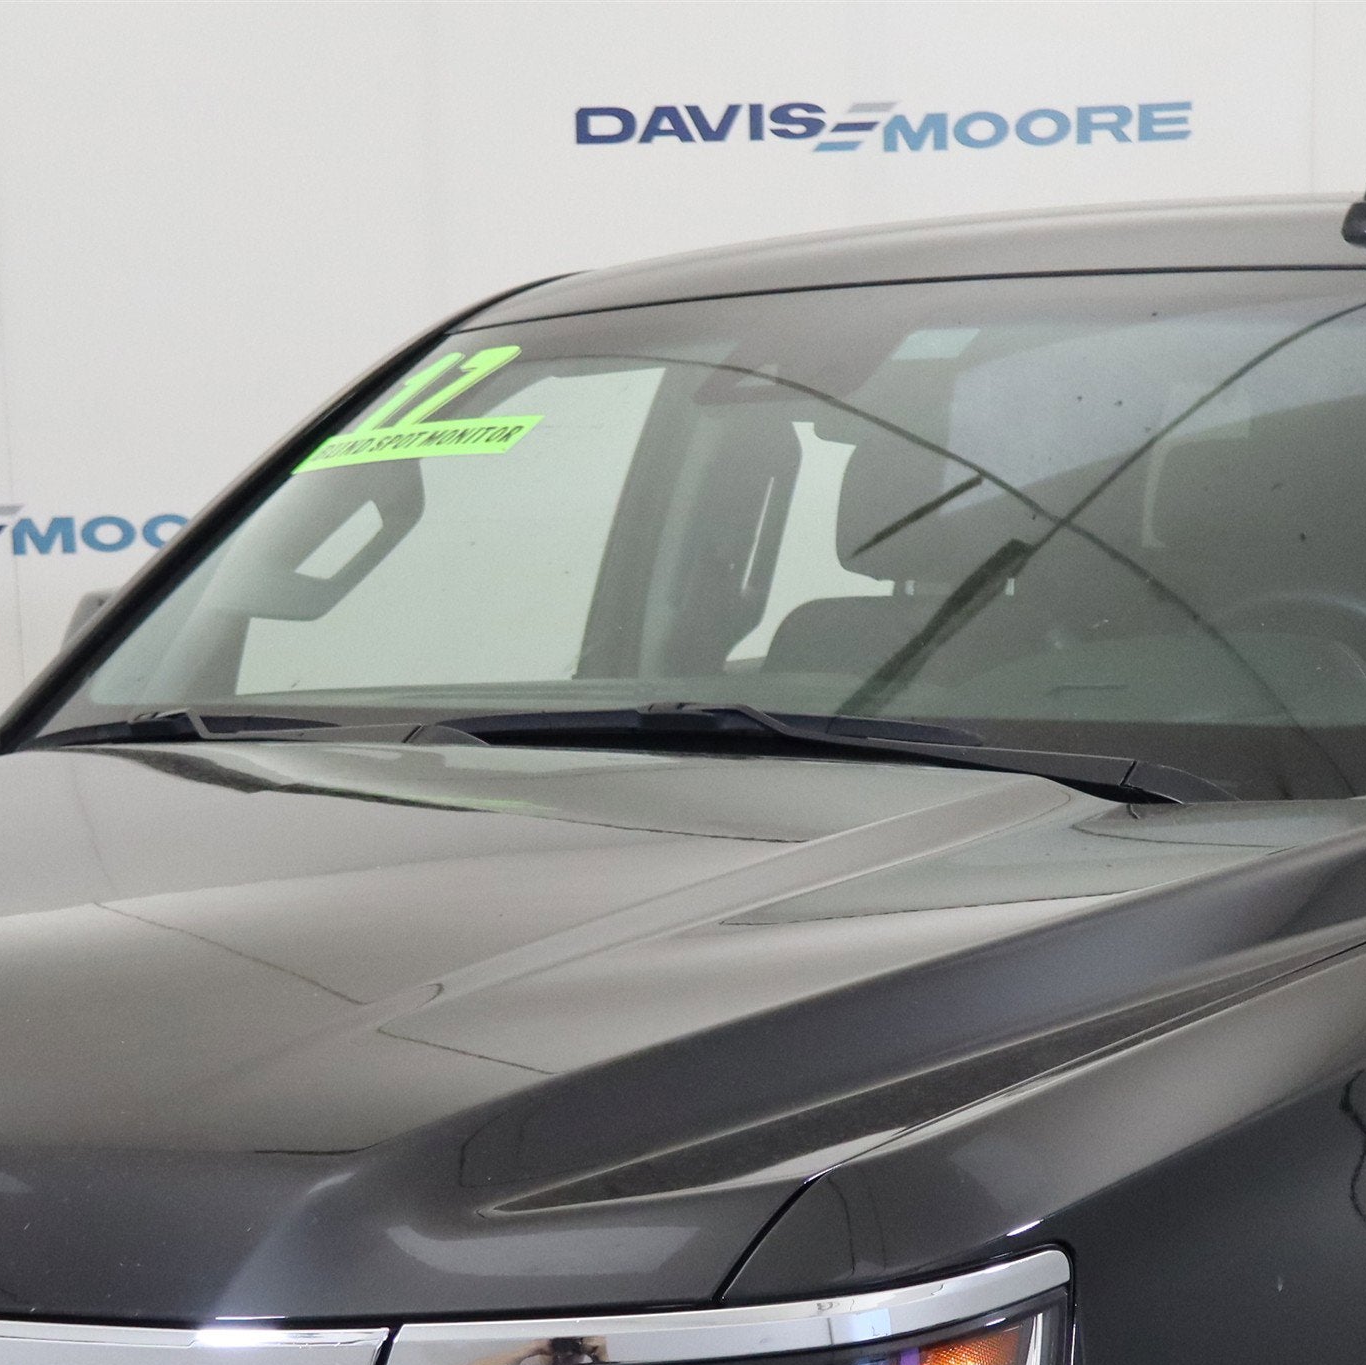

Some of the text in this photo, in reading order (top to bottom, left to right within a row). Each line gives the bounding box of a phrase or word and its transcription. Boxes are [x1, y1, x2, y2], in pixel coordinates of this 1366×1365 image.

[574, 101, 1192, 152] DAVIS MOORE
[419, 425, 524, 447] MONITOR
[11, 514, 189, 556] MOO
